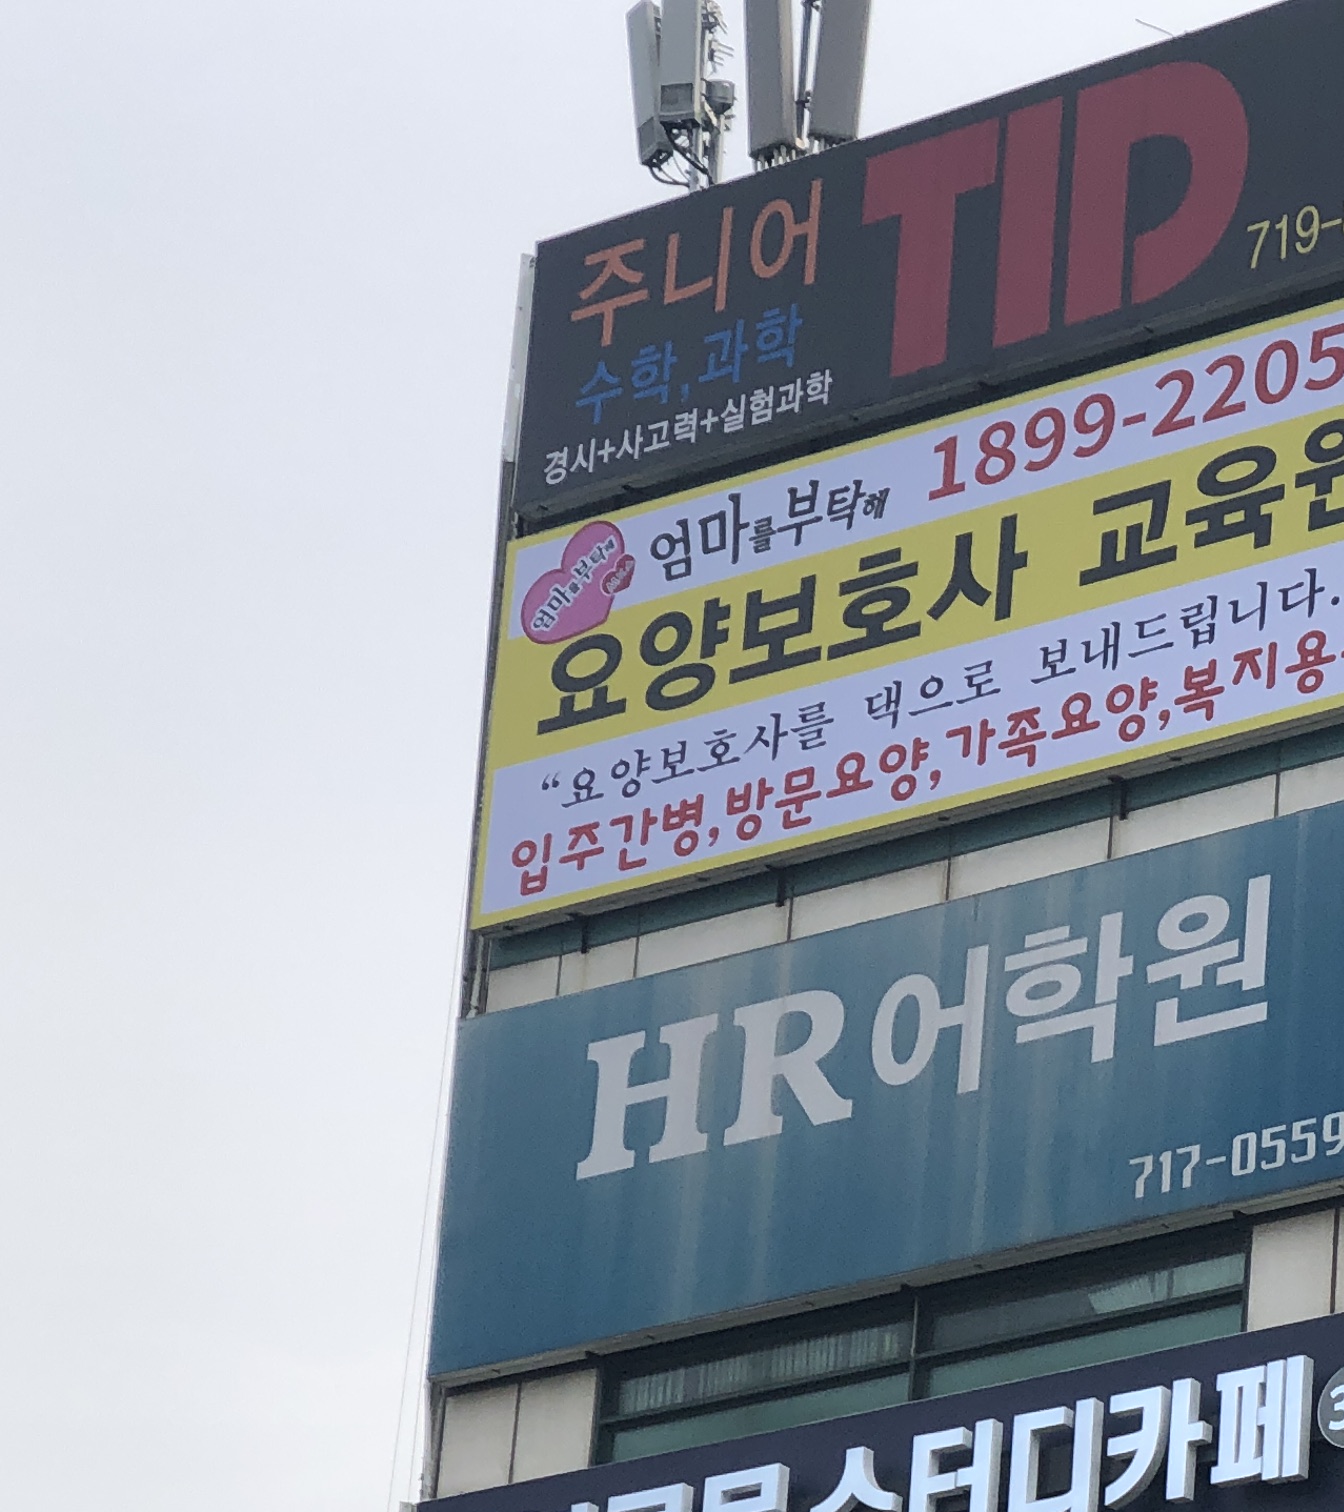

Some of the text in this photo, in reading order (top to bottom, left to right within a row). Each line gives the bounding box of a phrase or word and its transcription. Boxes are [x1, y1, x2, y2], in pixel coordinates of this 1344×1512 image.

[570, 178, 823, 347] 주니어
[860, 61, 1250, 378] TID
[575, 304, 803, 424] 수학,과학
[544, 369, 833, 485] 경시+사고력+실험과학
[650, 480, 890, 582] 엄마를부탁해
[536, 513, 1029, 736] 요양보호사
[866, 659, 1002, 730] 댁으로
